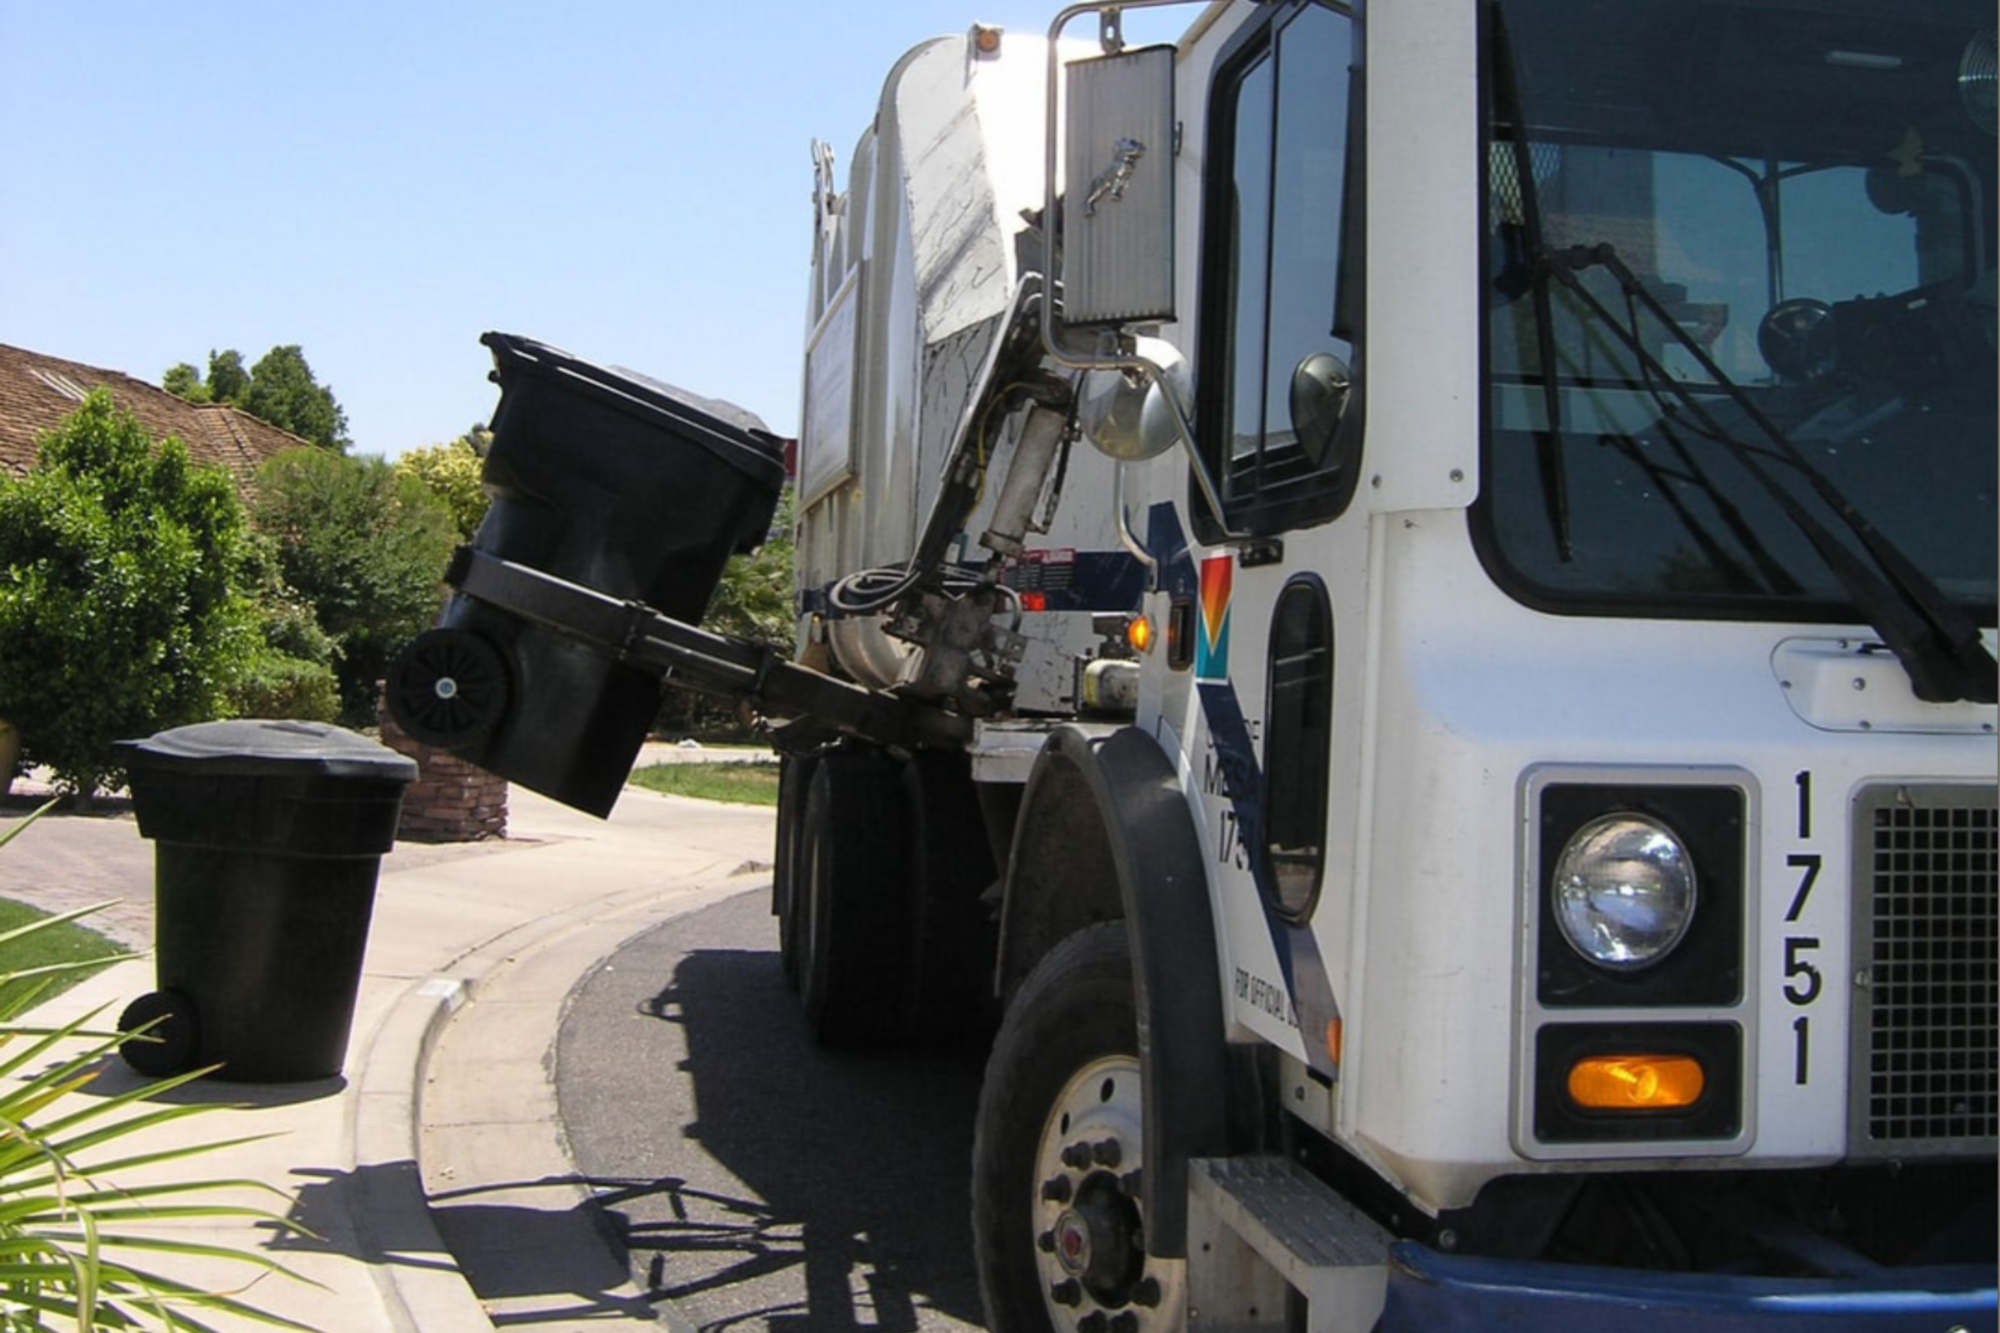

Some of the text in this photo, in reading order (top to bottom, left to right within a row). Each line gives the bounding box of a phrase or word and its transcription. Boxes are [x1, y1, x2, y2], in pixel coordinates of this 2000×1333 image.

[1235, 967, 1249, 1002] FOR
[1250, 975, 1285, 1022] OFFICIAL
[1784, 770, 1822, 1085] 1751
